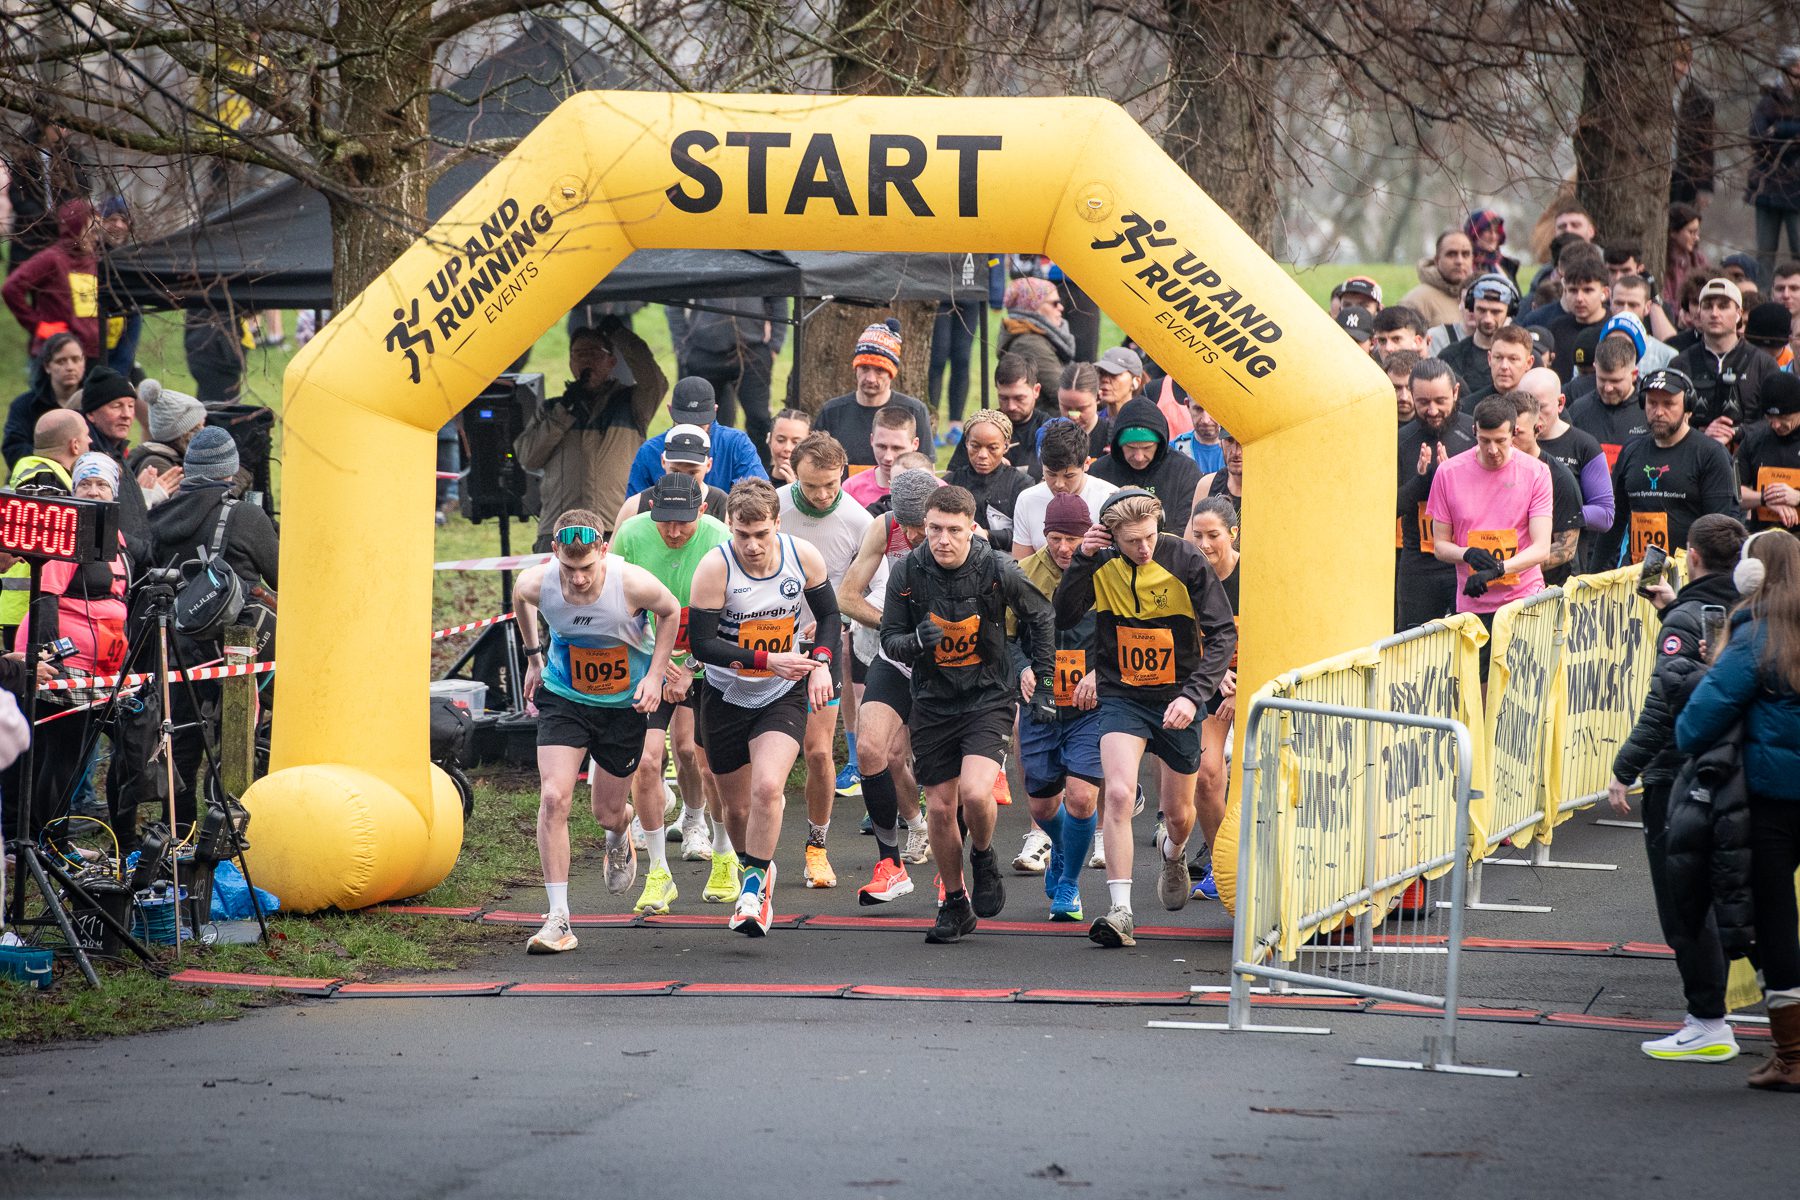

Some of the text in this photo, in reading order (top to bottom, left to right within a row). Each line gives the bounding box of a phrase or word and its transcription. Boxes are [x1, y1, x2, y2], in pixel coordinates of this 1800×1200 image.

[665, 130, 1002, 217] START
[422, 198, 519, 303] UP AND
[433, 204, 554, 340] RUNNING
[484, 261, 539, 324] EVENTS
[1172, 248, 1283, 344] UP AND
[1135, 260, 1277, 378] RUNNING
[1155, 311, 1219, 364] EVENTS
[1640, 490, 1663, 498] Syndrome
[1664, 490, 1686, 499] Scotland
[189, 590, 218, 615] HUUB
[726, 607, 786, 620] Edinburgh
[573, 615, 593, 626] WYN
[106, 637, 124, 664] 42
[743, 634, 791, 653] 1094
[941, 631, 979, 653] 069
[575, 658, 627, 683] 1095
[1122, 646, 1172, 672] 1087
